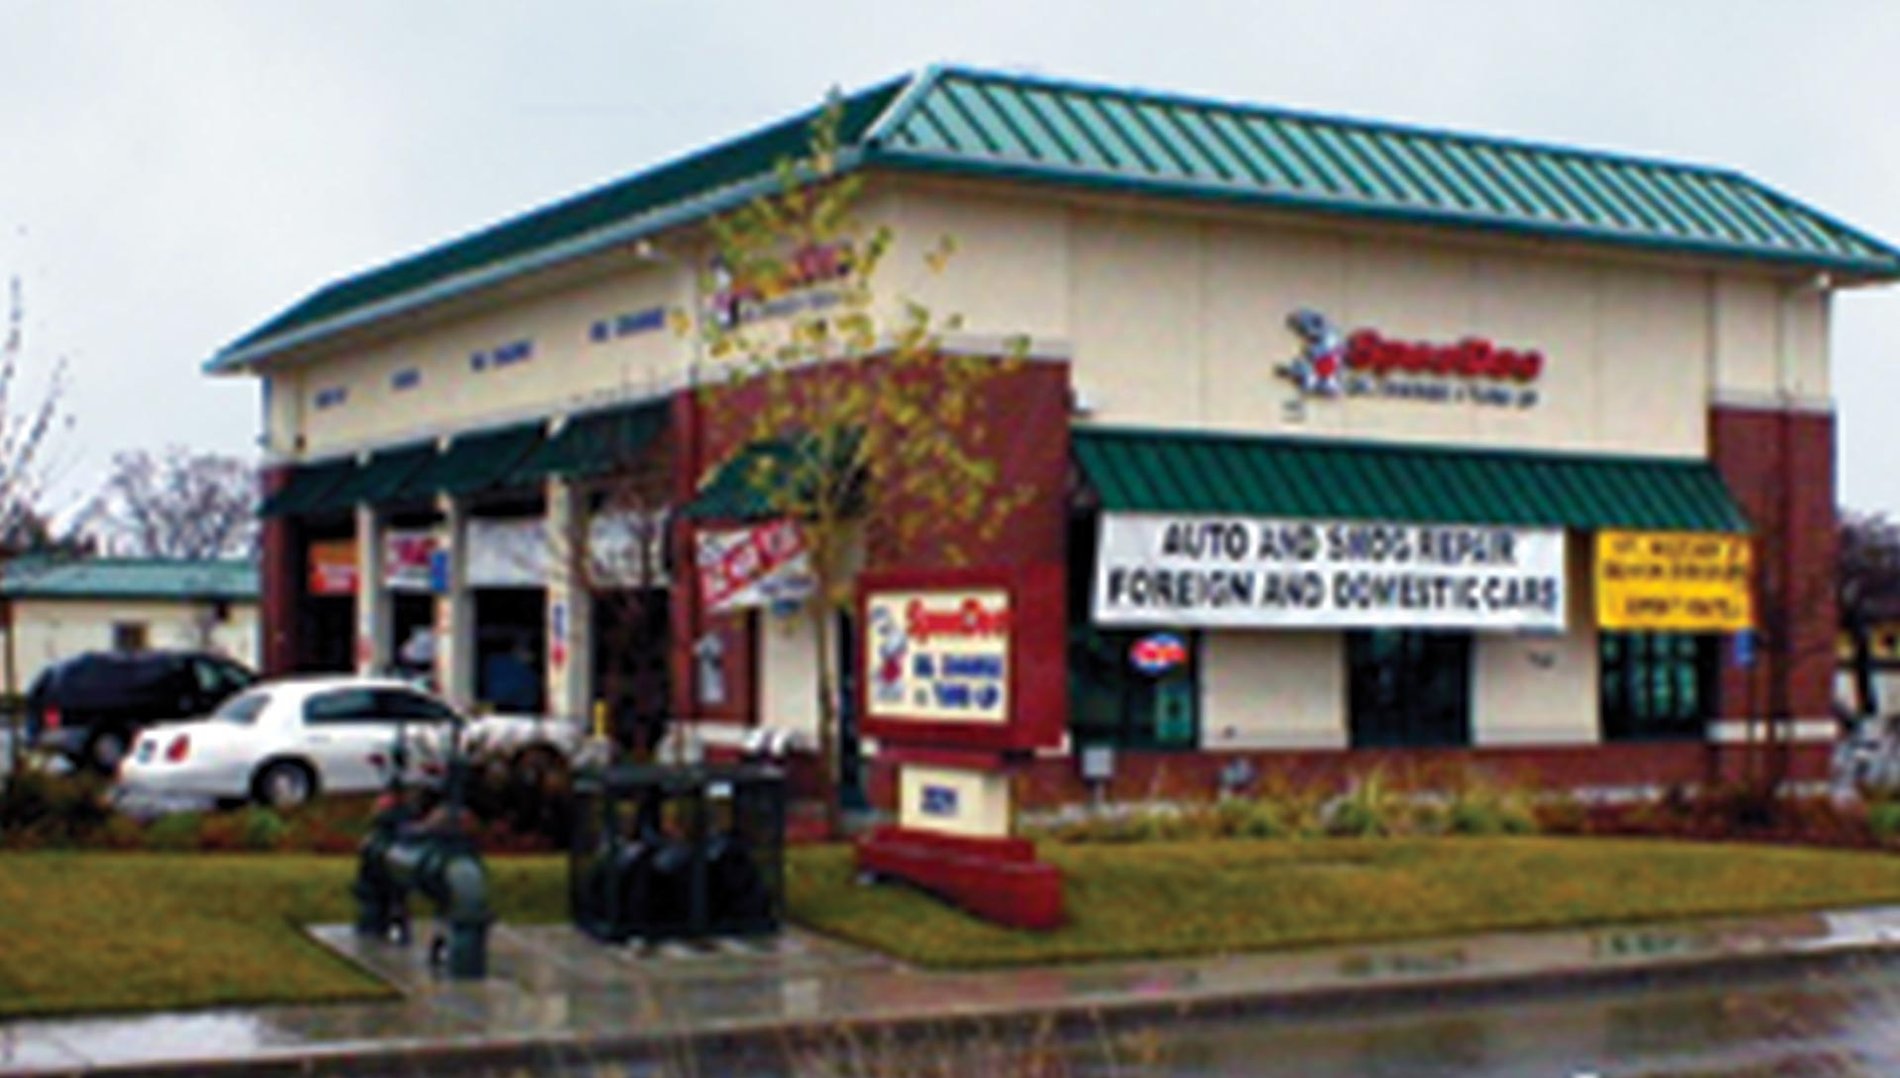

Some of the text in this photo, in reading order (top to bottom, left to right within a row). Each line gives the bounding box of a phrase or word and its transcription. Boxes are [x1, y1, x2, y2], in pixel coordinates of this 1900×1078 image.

[1163, 522, 1517, 566] AUTO AND SMOG REPAIR
[1108, 568, 1559, 613] FOREIGN AND DOMESTIC CARS
